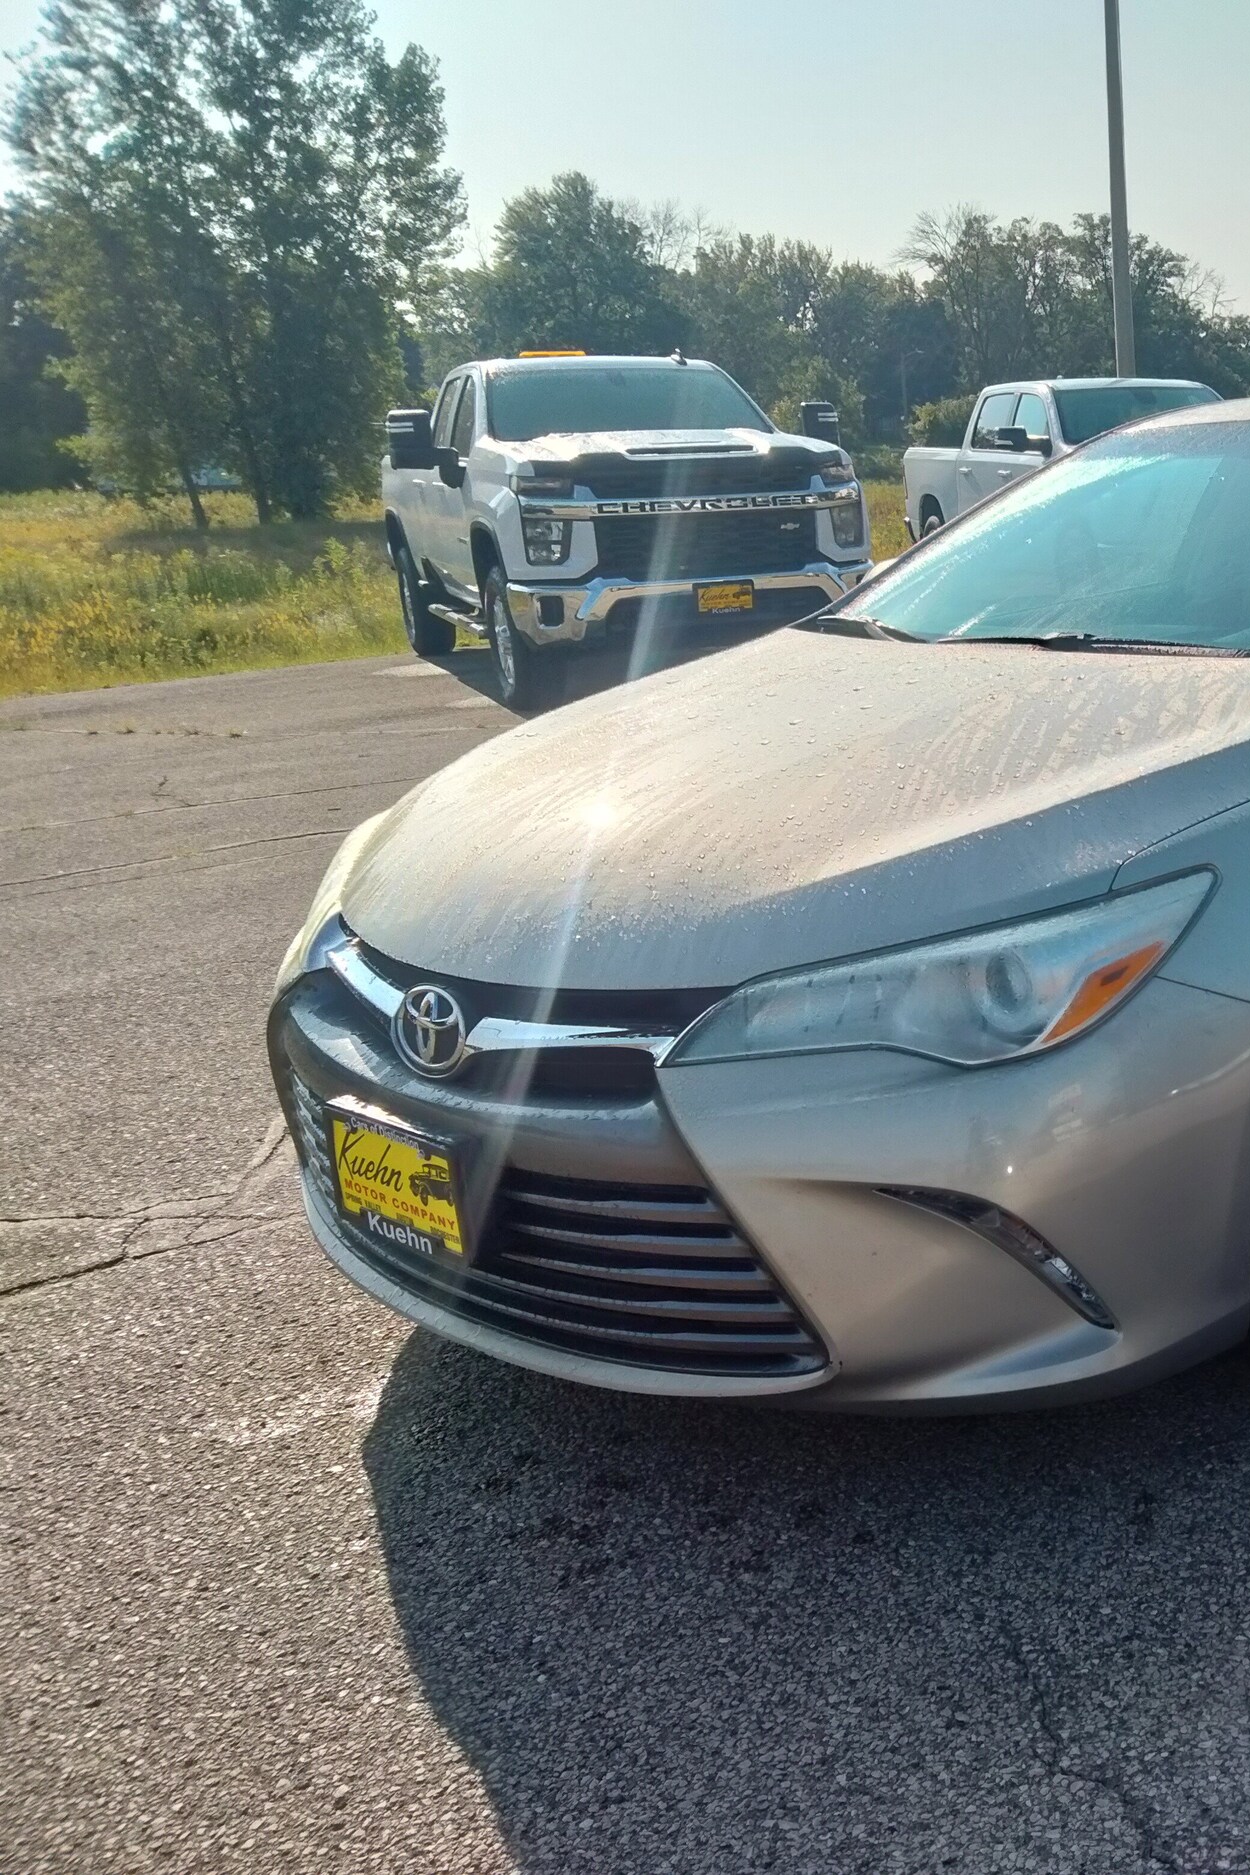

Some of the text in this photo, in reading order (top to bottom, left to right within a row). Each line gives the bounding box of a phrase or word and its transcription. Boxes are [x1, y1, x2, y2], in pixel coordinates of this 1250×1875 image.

[597, 494, 818, 513] CHEVROLET
[350, 1117, 369, 1131] Cars
[370, 1123, 378, 1135] of
[338, 1131, 403, 1192] Kuehn
[344, 1178, 387, 1204] MOTOR
[391, 1197, 456, 1230] COMPANY
[367, 1211, 432, 1255] Kuehn
